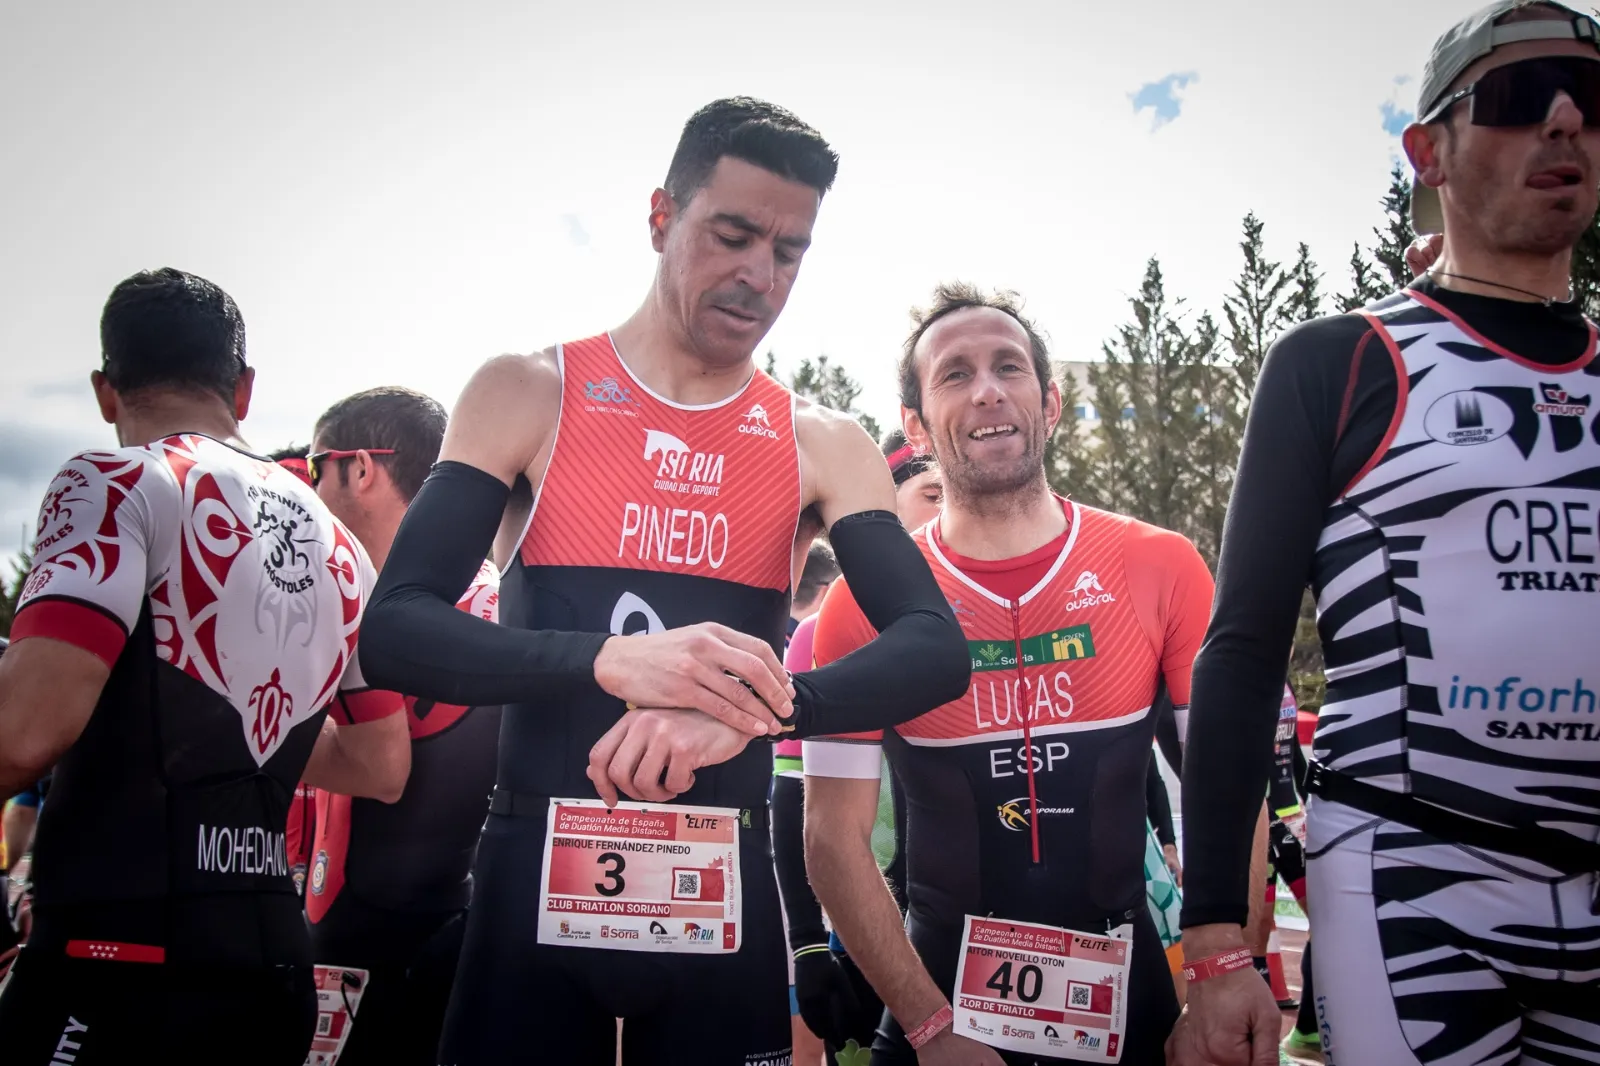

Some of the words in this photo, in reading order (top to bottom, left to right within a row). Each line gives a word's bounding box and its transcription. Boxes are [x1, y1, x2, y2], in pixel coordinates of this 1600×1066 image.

[1534, 402, 1587, 416] amura
[738, 424, 780, 440] austral
[654, 480, 678, 492] CIUDAD
[678, 483, 690, 494] DEL
[692, 484, 720, 496] DEPORTE
[258, 486, 314, 522] INFINITY
[618, 502, 728, 569] PINEDO
[1486, 498, 1600, 564] CRE
[1496, 572, 1600, 592] TRIAT
[1066, 593, 1116, 612] austral
[1052, 632, 1084, 660] in
[1062, 632, 1085, 642] JOVEN
[972, 658, 982, 670] ja
[972, 672, 1074, 728] LUCAS
[1448, 675, 1600, 713] inforh
[990, 742, 1070, 778] ESP
[560, 813, 616, 825] Campeonato
[632, 818, 664, 828] España
[571, 822, 602, 832] Duatlón
[604, 824, 629, 834] Media
[632, 826, 669, 836] Distancia
[687, 818, 718, 830] ELITE
[198, 824, 287, 876] MOHEDANO
[552, 838, 594, 850] ENRIQUE
[596, 838, 654, 852] FERNÁNDEZ
[656, 844, 690, 854] PINEDO
[594, 852, 626, 897] 3
[548, 900, 572, 910] CLUB
[575, 900, 624, 913] TRIATLON
[627, 902, 670, 915] SORIANO
[610, 929, 639, 939] Soria
[975, 926, 1022, 938] Campeonato
[1036, 935, 1062, 945] España
[984, 935, 1010, 944] Duatlón
[1011, 938, 1032, 947] Media
[1080, 940, 1108, 951] ELITE
[968, 946, 993, 956] AITOR
[995, 949, 1039, 963] NOVEILLO
[1041, 956, 1064, 967] OTON
[986, 962, 1043, 1003] 40
[959, 998, 981, 1010] FLOR
[983, 1001, 994, 1011] DE
[996, 1004, 1035, 1017] TRIATLO
[1011, 1029, 1035, 1039] Soria
